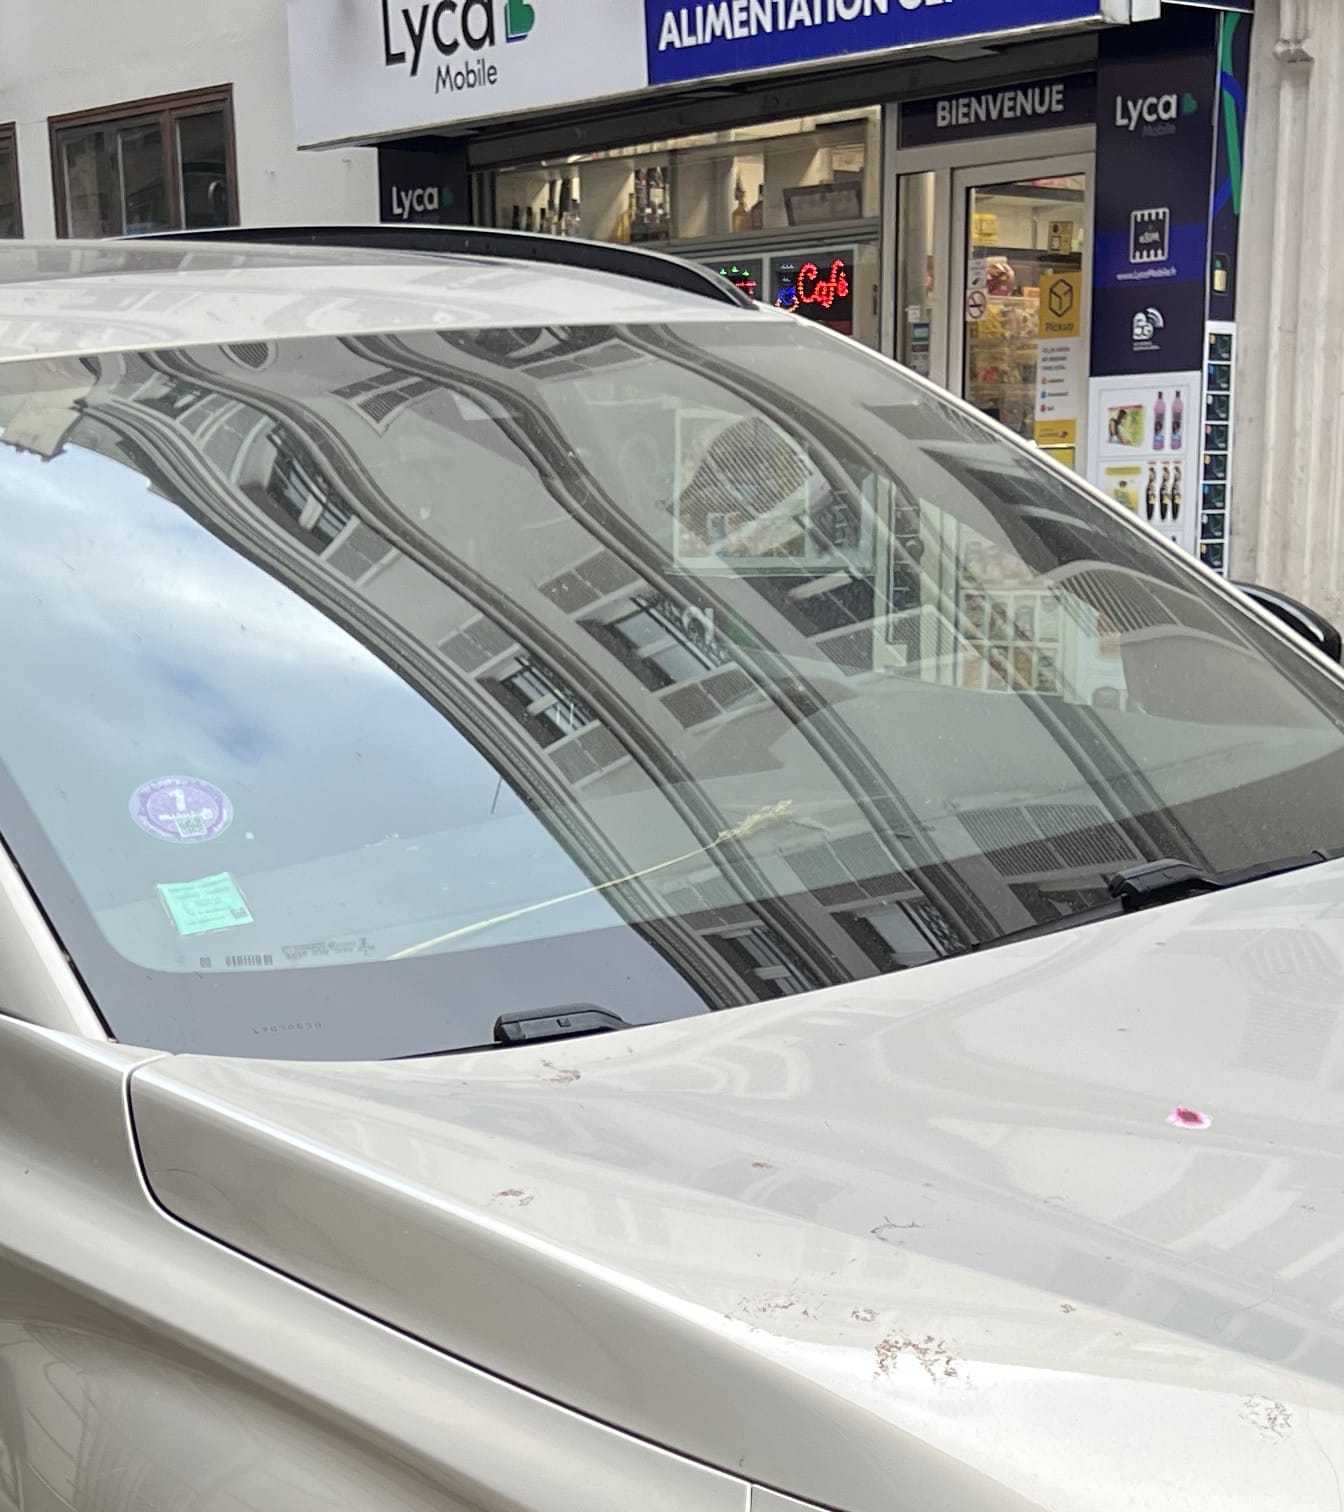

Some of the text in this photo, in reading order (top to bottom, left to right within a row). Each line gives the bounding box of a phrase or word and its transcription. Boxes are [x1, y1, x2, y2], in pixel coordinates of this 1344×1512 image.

[383, 0, 495, 77] Lyca
[435, 58, 498, 94] Mobile
[936, 85, 1065, 128] BIENVENUE
[1115, 93, 1177, 131] Lyca
[392, 185, 439, 219] Lyca
